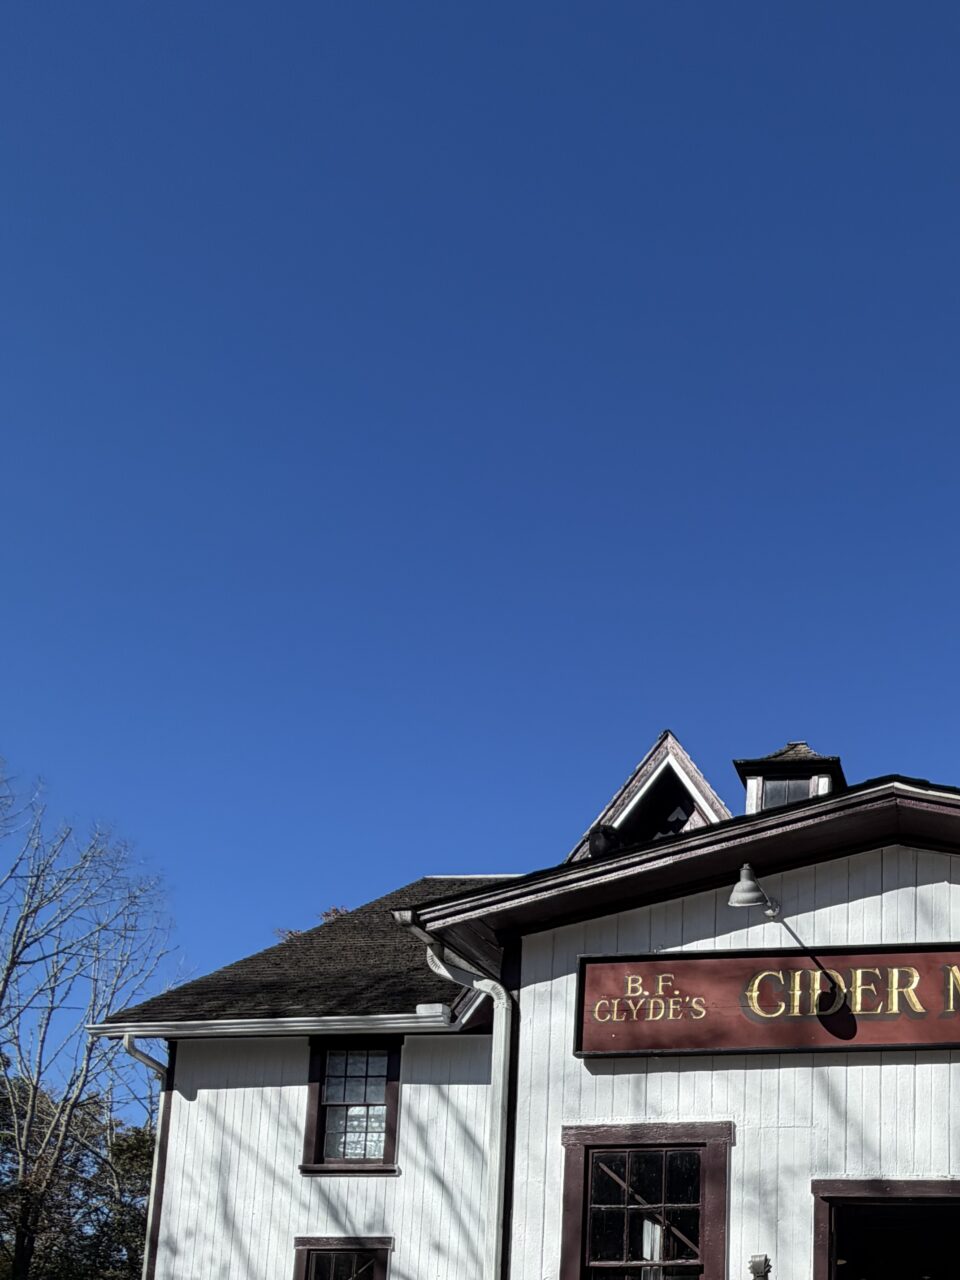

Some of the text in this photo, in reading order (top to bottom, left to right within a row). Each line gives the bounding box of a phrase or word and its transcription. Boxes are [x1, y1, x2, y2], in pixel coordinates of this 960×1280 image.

[625, 974, 680, 997] B. F.
[745, 966, 927, 1018] CIDER
[594, 996, 707, 1022] CLYDE'S
